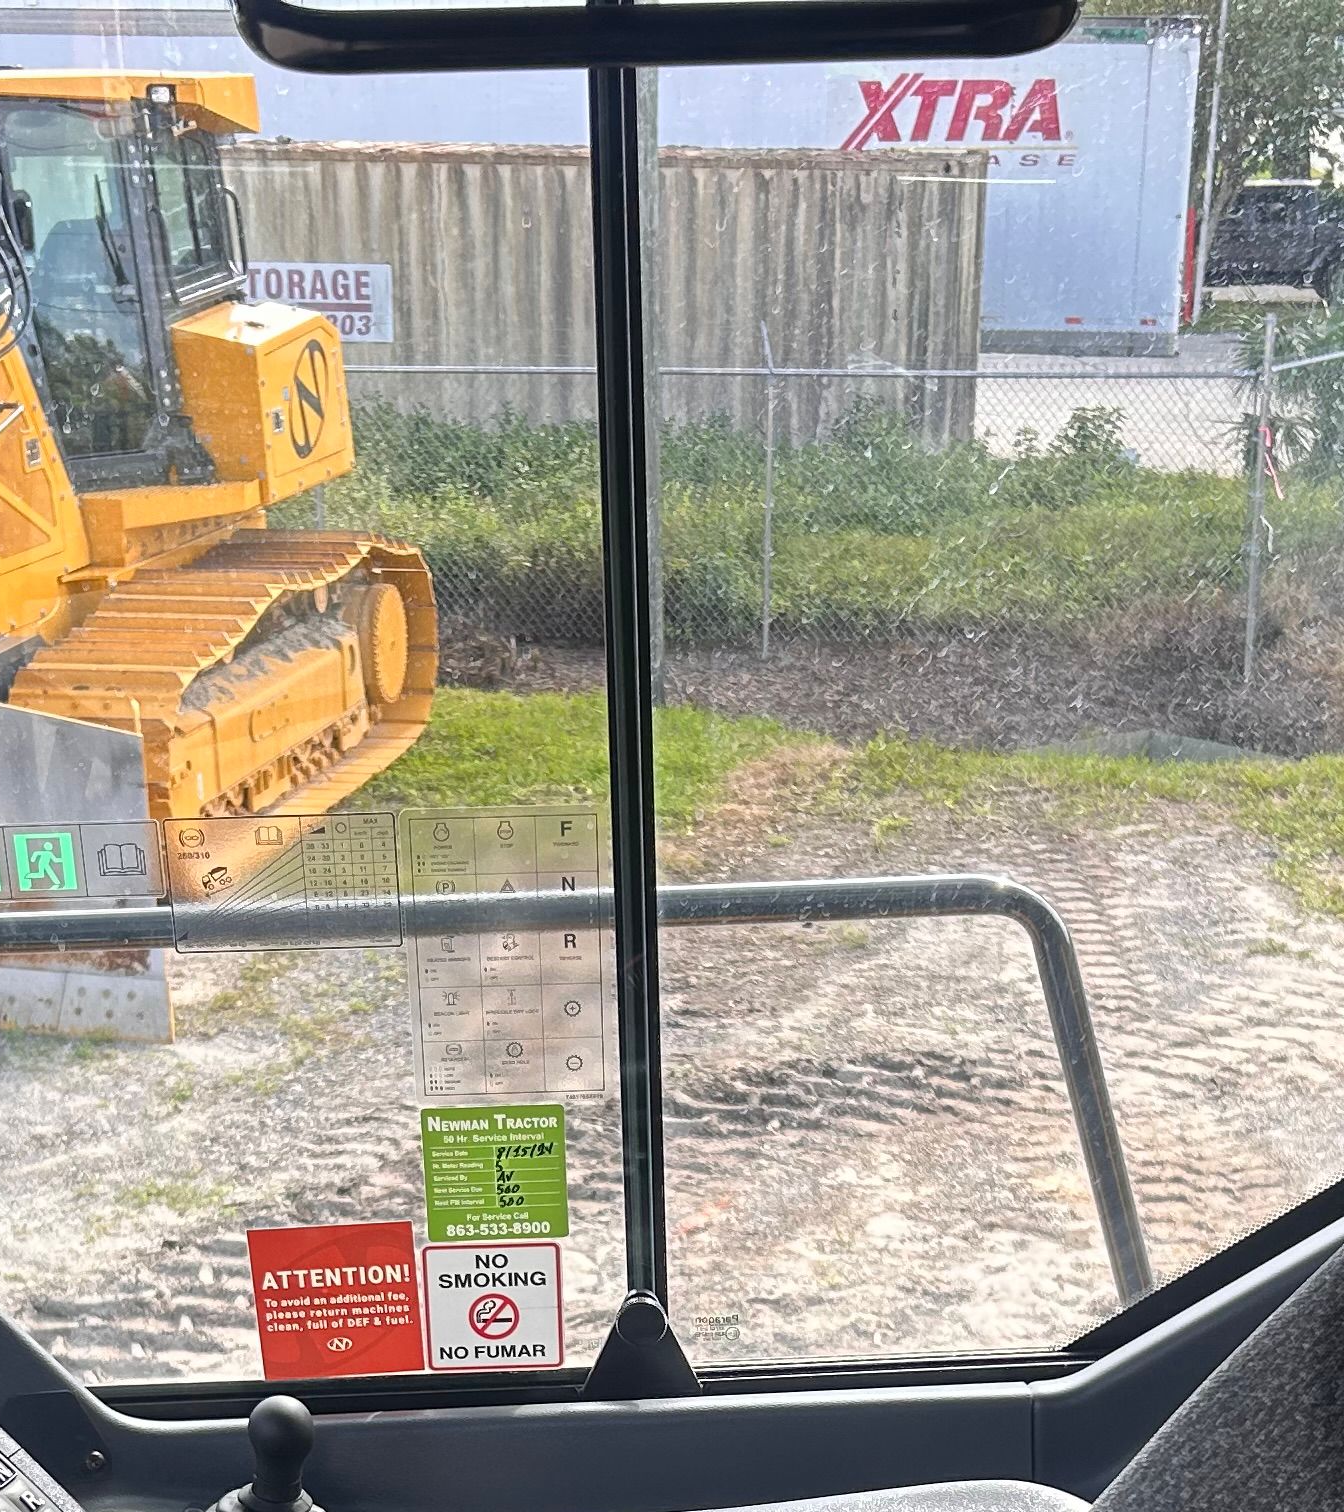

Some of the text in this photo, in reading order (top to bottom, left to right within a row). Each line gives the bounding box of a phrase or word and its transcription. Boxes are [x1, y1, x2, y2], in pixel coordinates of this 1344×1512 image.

[840, 73, 1062, 151] XTRA
[987, 154, 1077, 167] ASE
[248, 268, 371, 301] TORAGE
[560, 821, 573, 837] F
[561, 876, 576, 892] N
[564, 933, 577, 949] R
[427, 1114, 558, 1131] NEWMAN TRACTOR
[443, 1135, 454, 1144] 50
[473, 1134, 507, 1143] Service
[510, 1132, 544, 1141] Interval
[467, 1212, 529, 1221] For Service Call
[446, 1221, 551, 1237] 863-533-8900
[475, 1253, 509, 1269] NO
[262, 1264, 411, 1291] ATTENTION!
[438, 1271, 547, 1289] SMOKING
[264, 1292, 410, 1308] To avoid an additional fee,
[265, 1304, 410, 1321] please return machines
[267, 1315, 414, 1332] clean, full of DEF & fuel.
[439, 1344, 546, 1360] NO FUMAR
[19, 1490, 43, 1512] R
